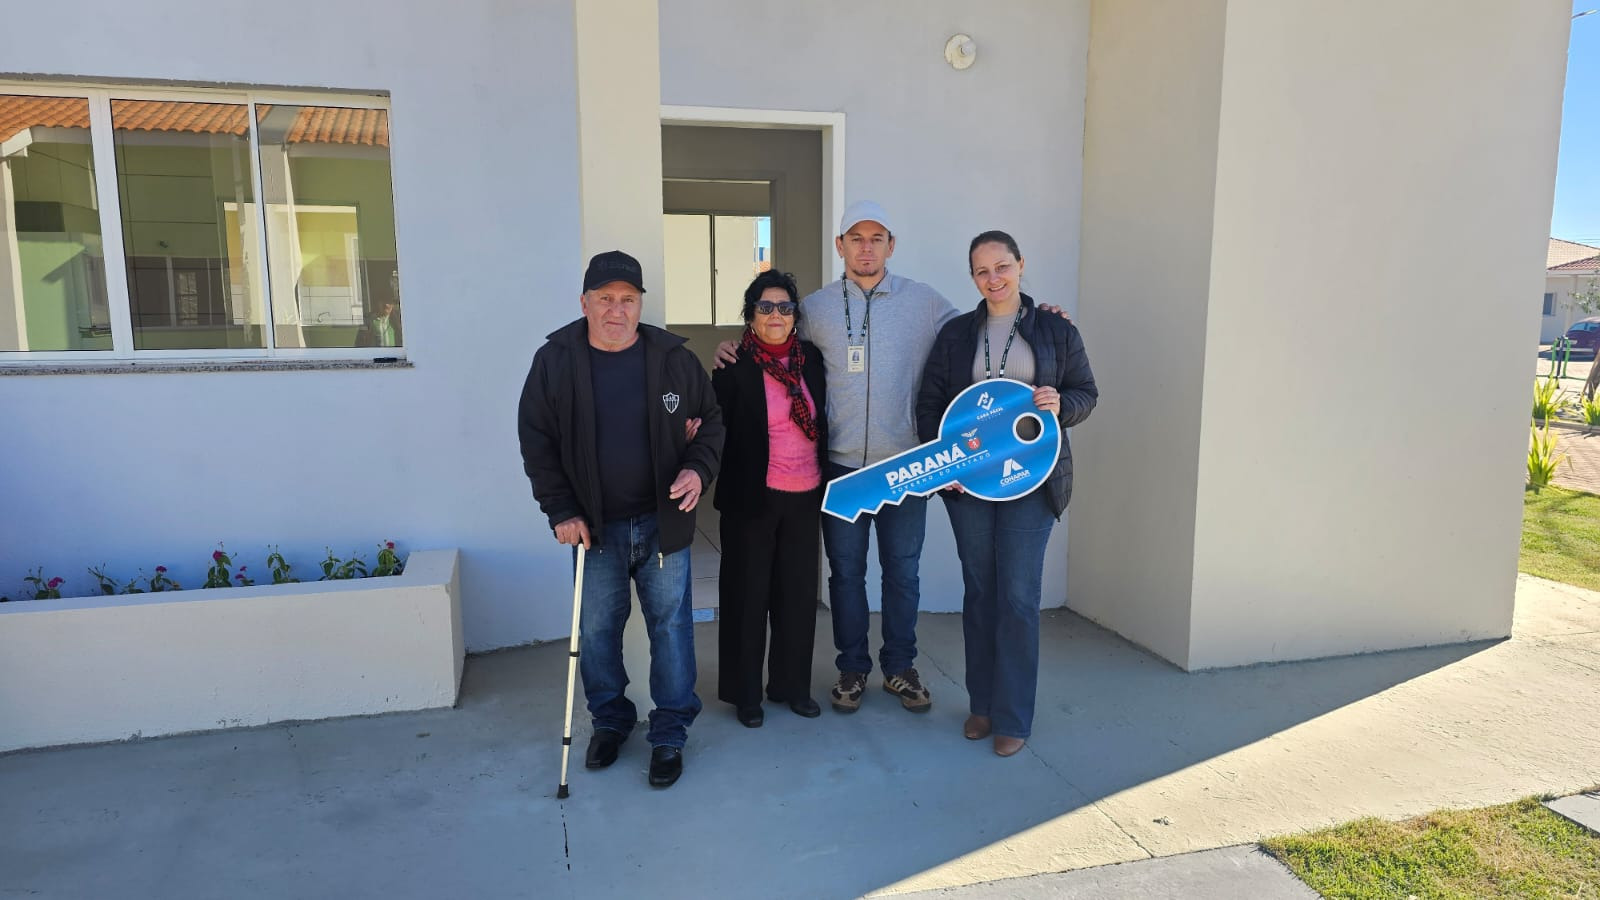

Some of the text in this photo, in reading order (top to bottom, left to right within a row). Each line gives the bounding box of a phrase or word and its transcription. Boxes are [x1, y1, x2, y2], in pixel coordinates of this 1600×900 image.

[885, 443, 967, 487] PARANÁ
[892, 452, 991, 495] GOVERNO DO ESTADO
